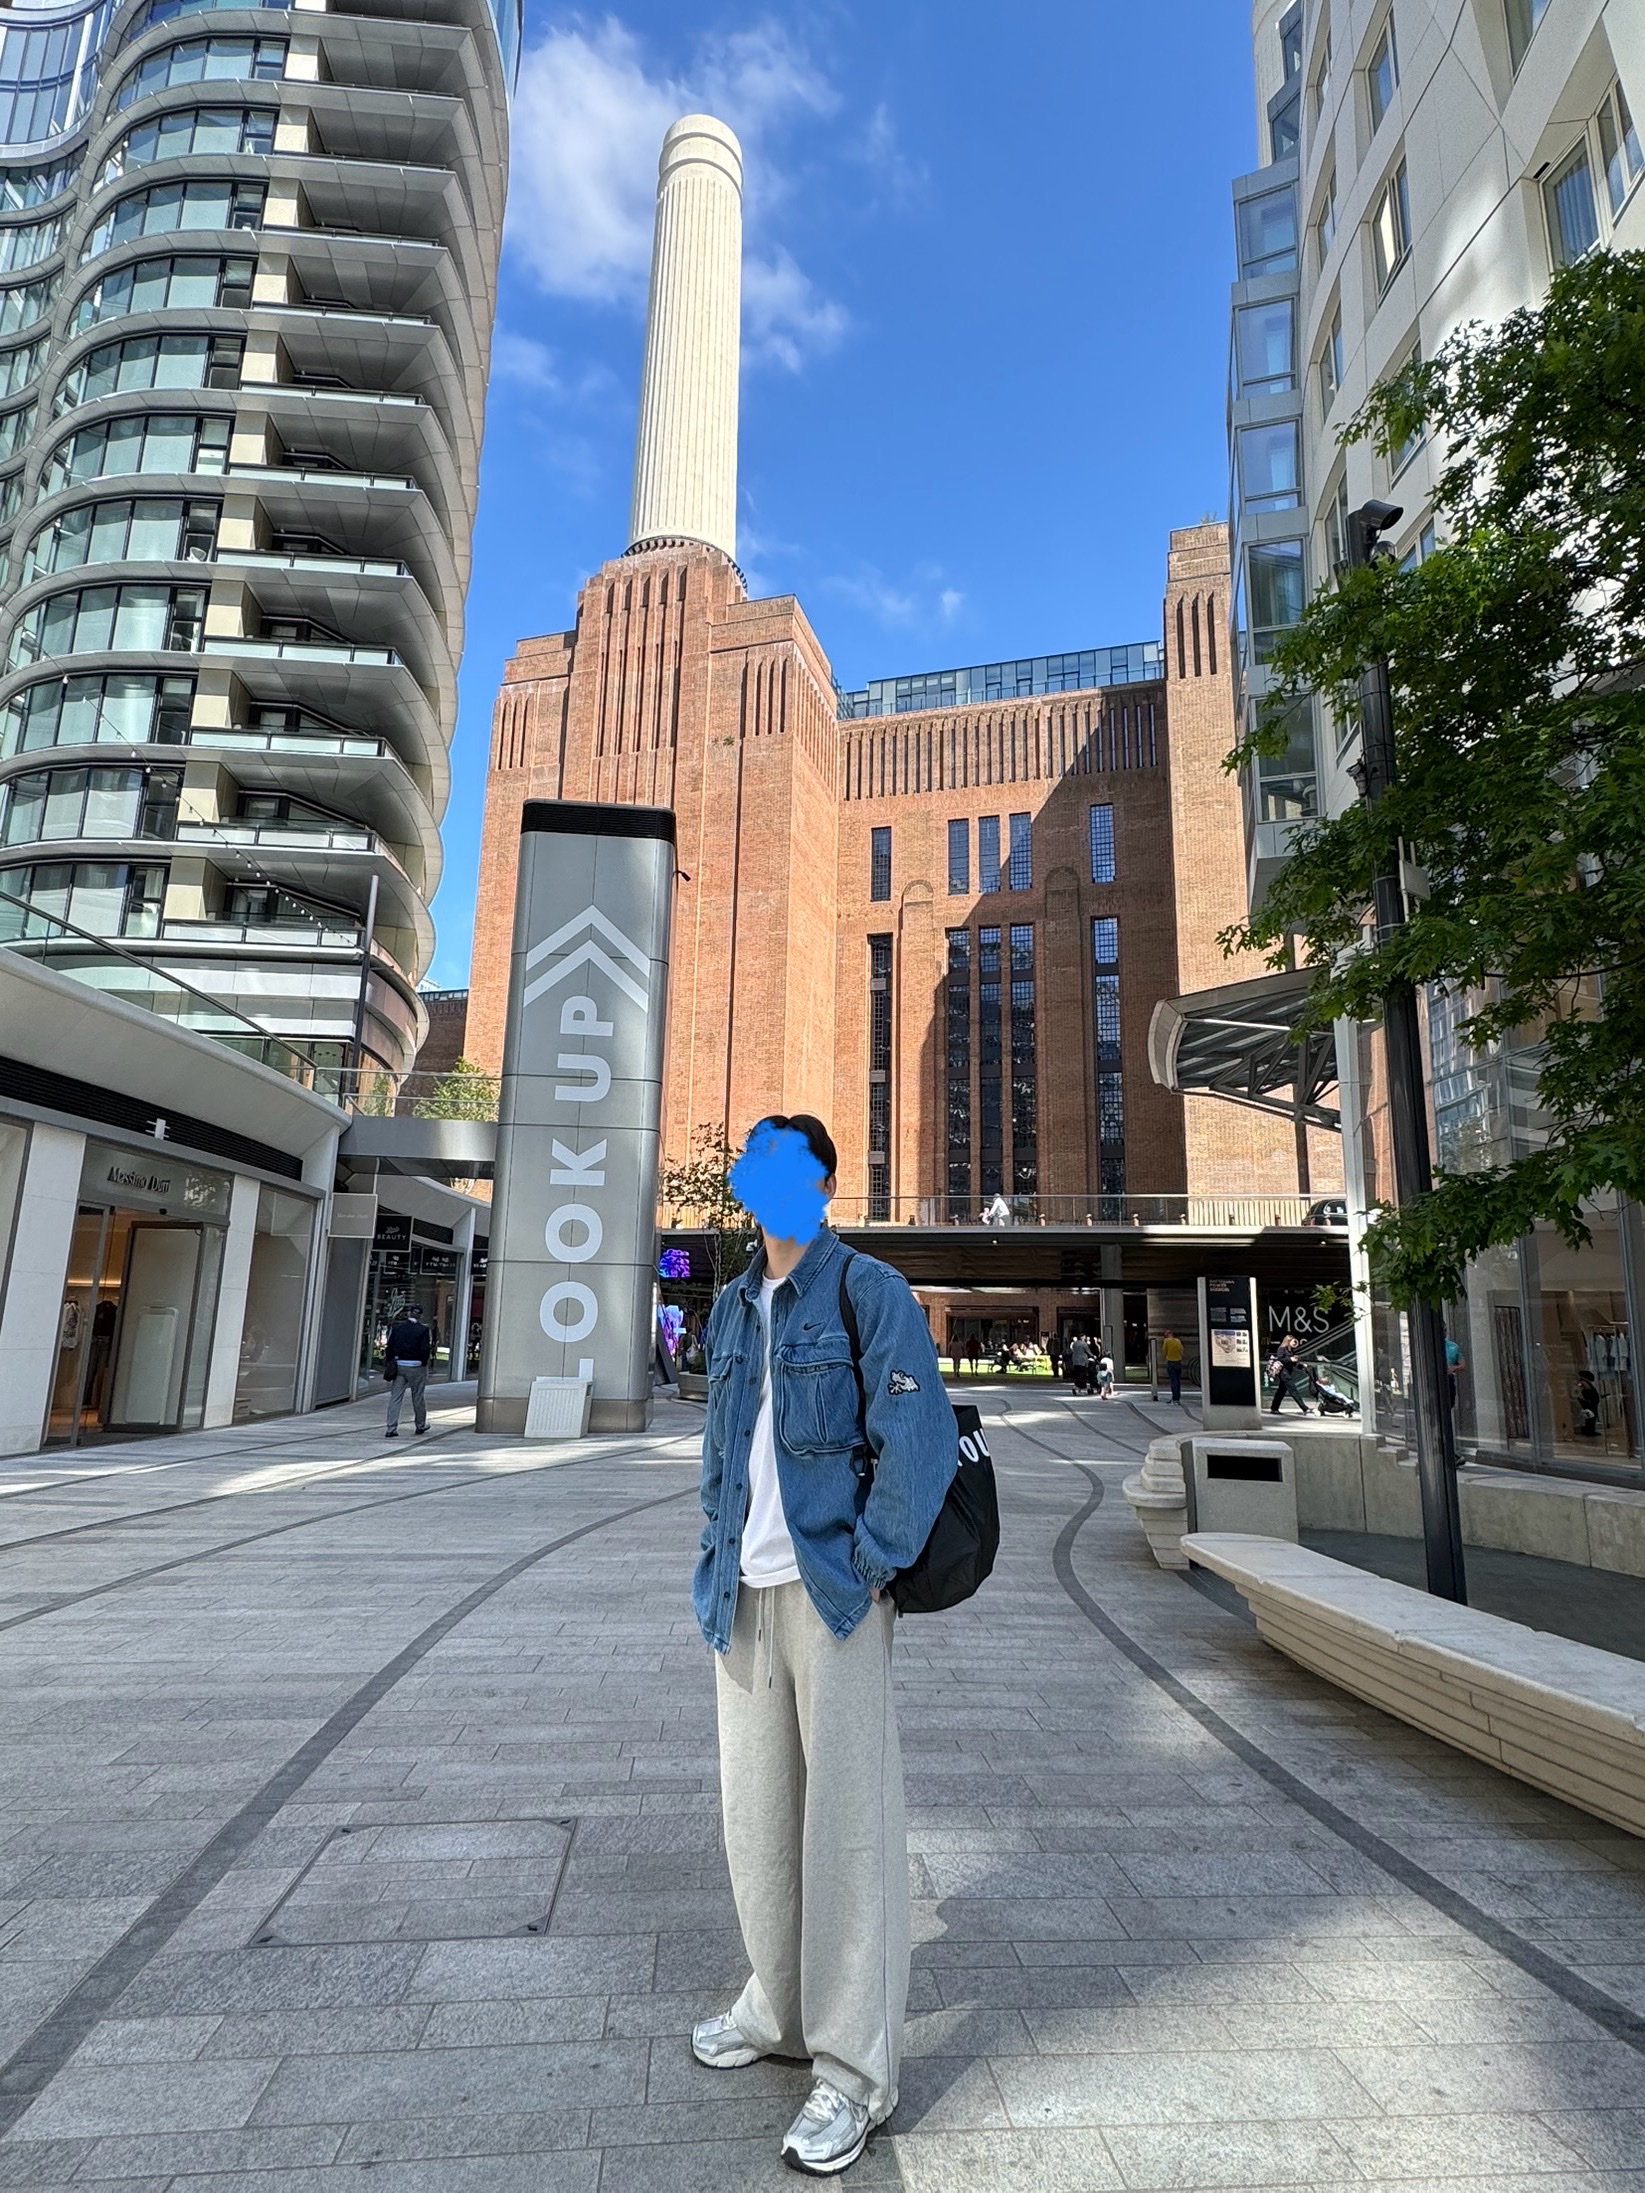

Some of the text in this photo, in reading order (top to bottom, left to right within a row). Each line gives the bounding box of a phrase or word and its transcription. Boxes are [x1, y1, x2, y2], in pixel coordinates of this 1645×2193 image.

[554, 995, 614, 1102] UP
[377, 1233, 407, 1241] BEAUTY
[1268, 1305, 1330, 1333] M&S
